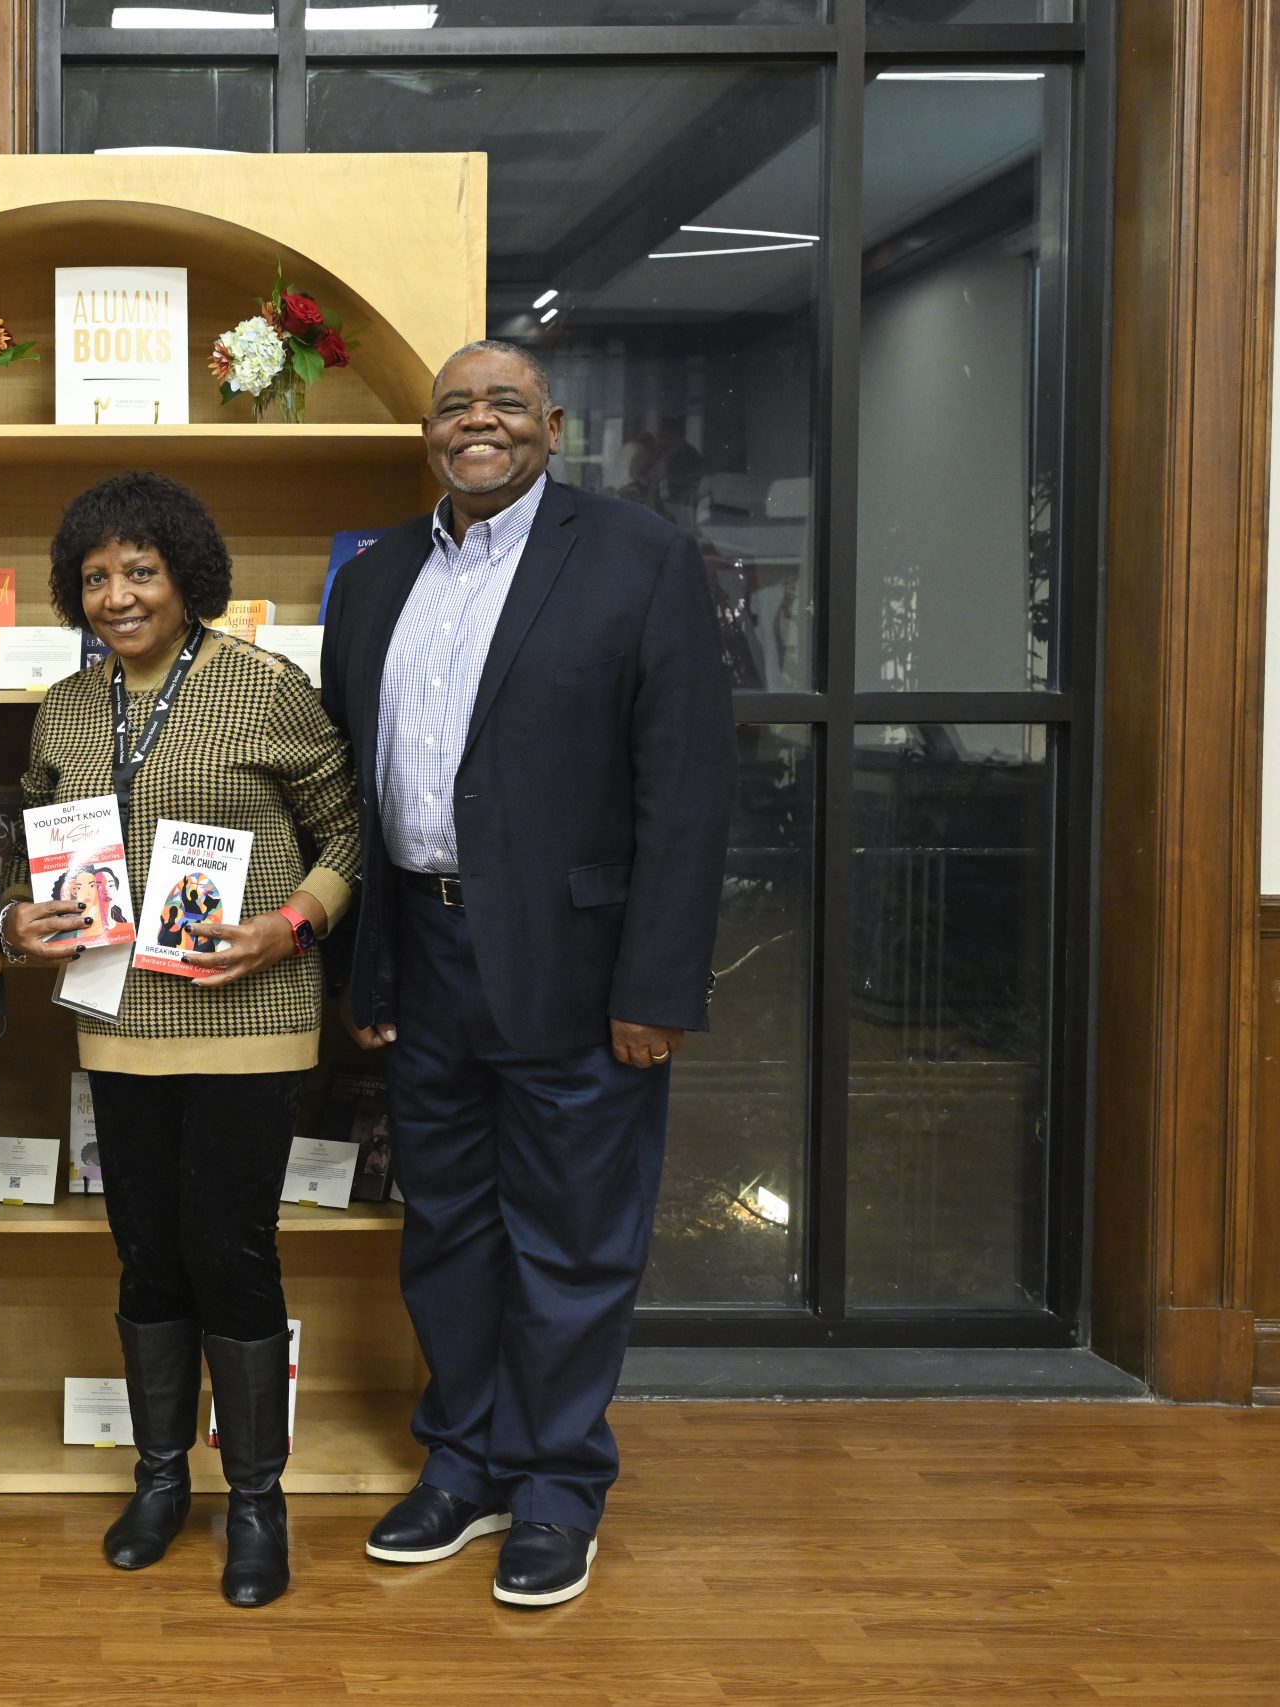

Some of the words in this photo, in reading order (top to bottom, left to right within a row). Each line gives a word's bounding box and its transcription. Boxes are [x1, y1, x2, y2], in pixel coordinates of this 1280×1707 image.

[72, 290, 169, 324] ALUMNI
[73, 327, 172, 364] BOOKS
[358, 539, 378, 547] LIVIN
[227, 604, 261, 614] piritual
[225, 616, 254, 628] Aging
[34, 819, 52, 829] YOU
[54, 814, 81, 825] DON'T
[83, 809, 111, 820] KNOW
[50, 828, 65, 852] My
[172, 830, 235, 853] ABORTION
[188, 848, 200, 857] AND
[202, 850, 215, 859] THE
[172, 854, 196, 867] BLACK
[196, 858, 228, 872] CHURCH
[145, 946, 180, 957] BREAKING
[141, 956, 166, 966] Barbara
[167, 961, 193, 970] Conwell
